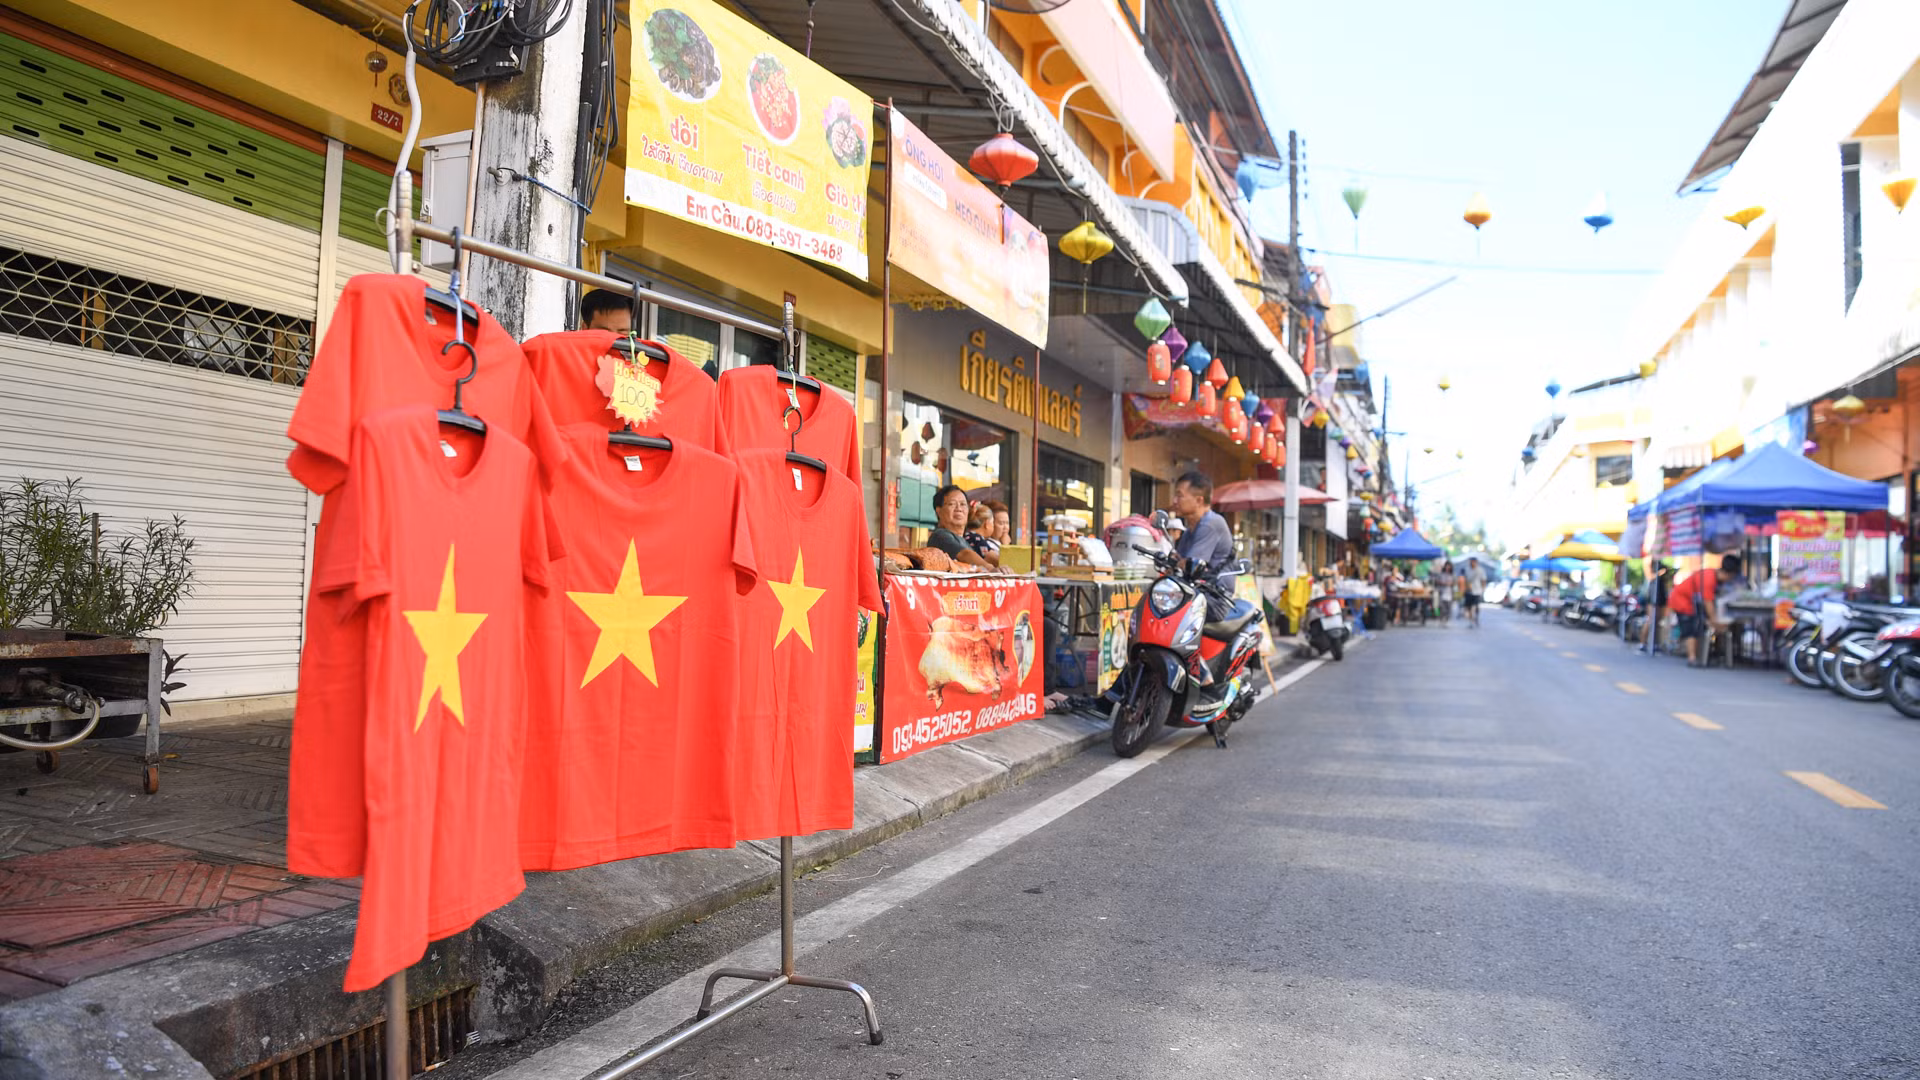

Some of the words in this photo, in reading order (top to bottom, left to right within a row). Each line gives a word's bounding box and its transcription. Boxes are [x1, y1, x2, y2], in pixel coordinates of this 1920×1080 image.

[376, 108, 400, 127] 22/7
[774, 164, 805, 192] canh
[686, 194, 708, 220] Em
[825, 182, 849, 207] Giò
[955, 199, 973, 227] HEO
[637, 369, 661, 391] item
[619, 383, 647, 408] 100
